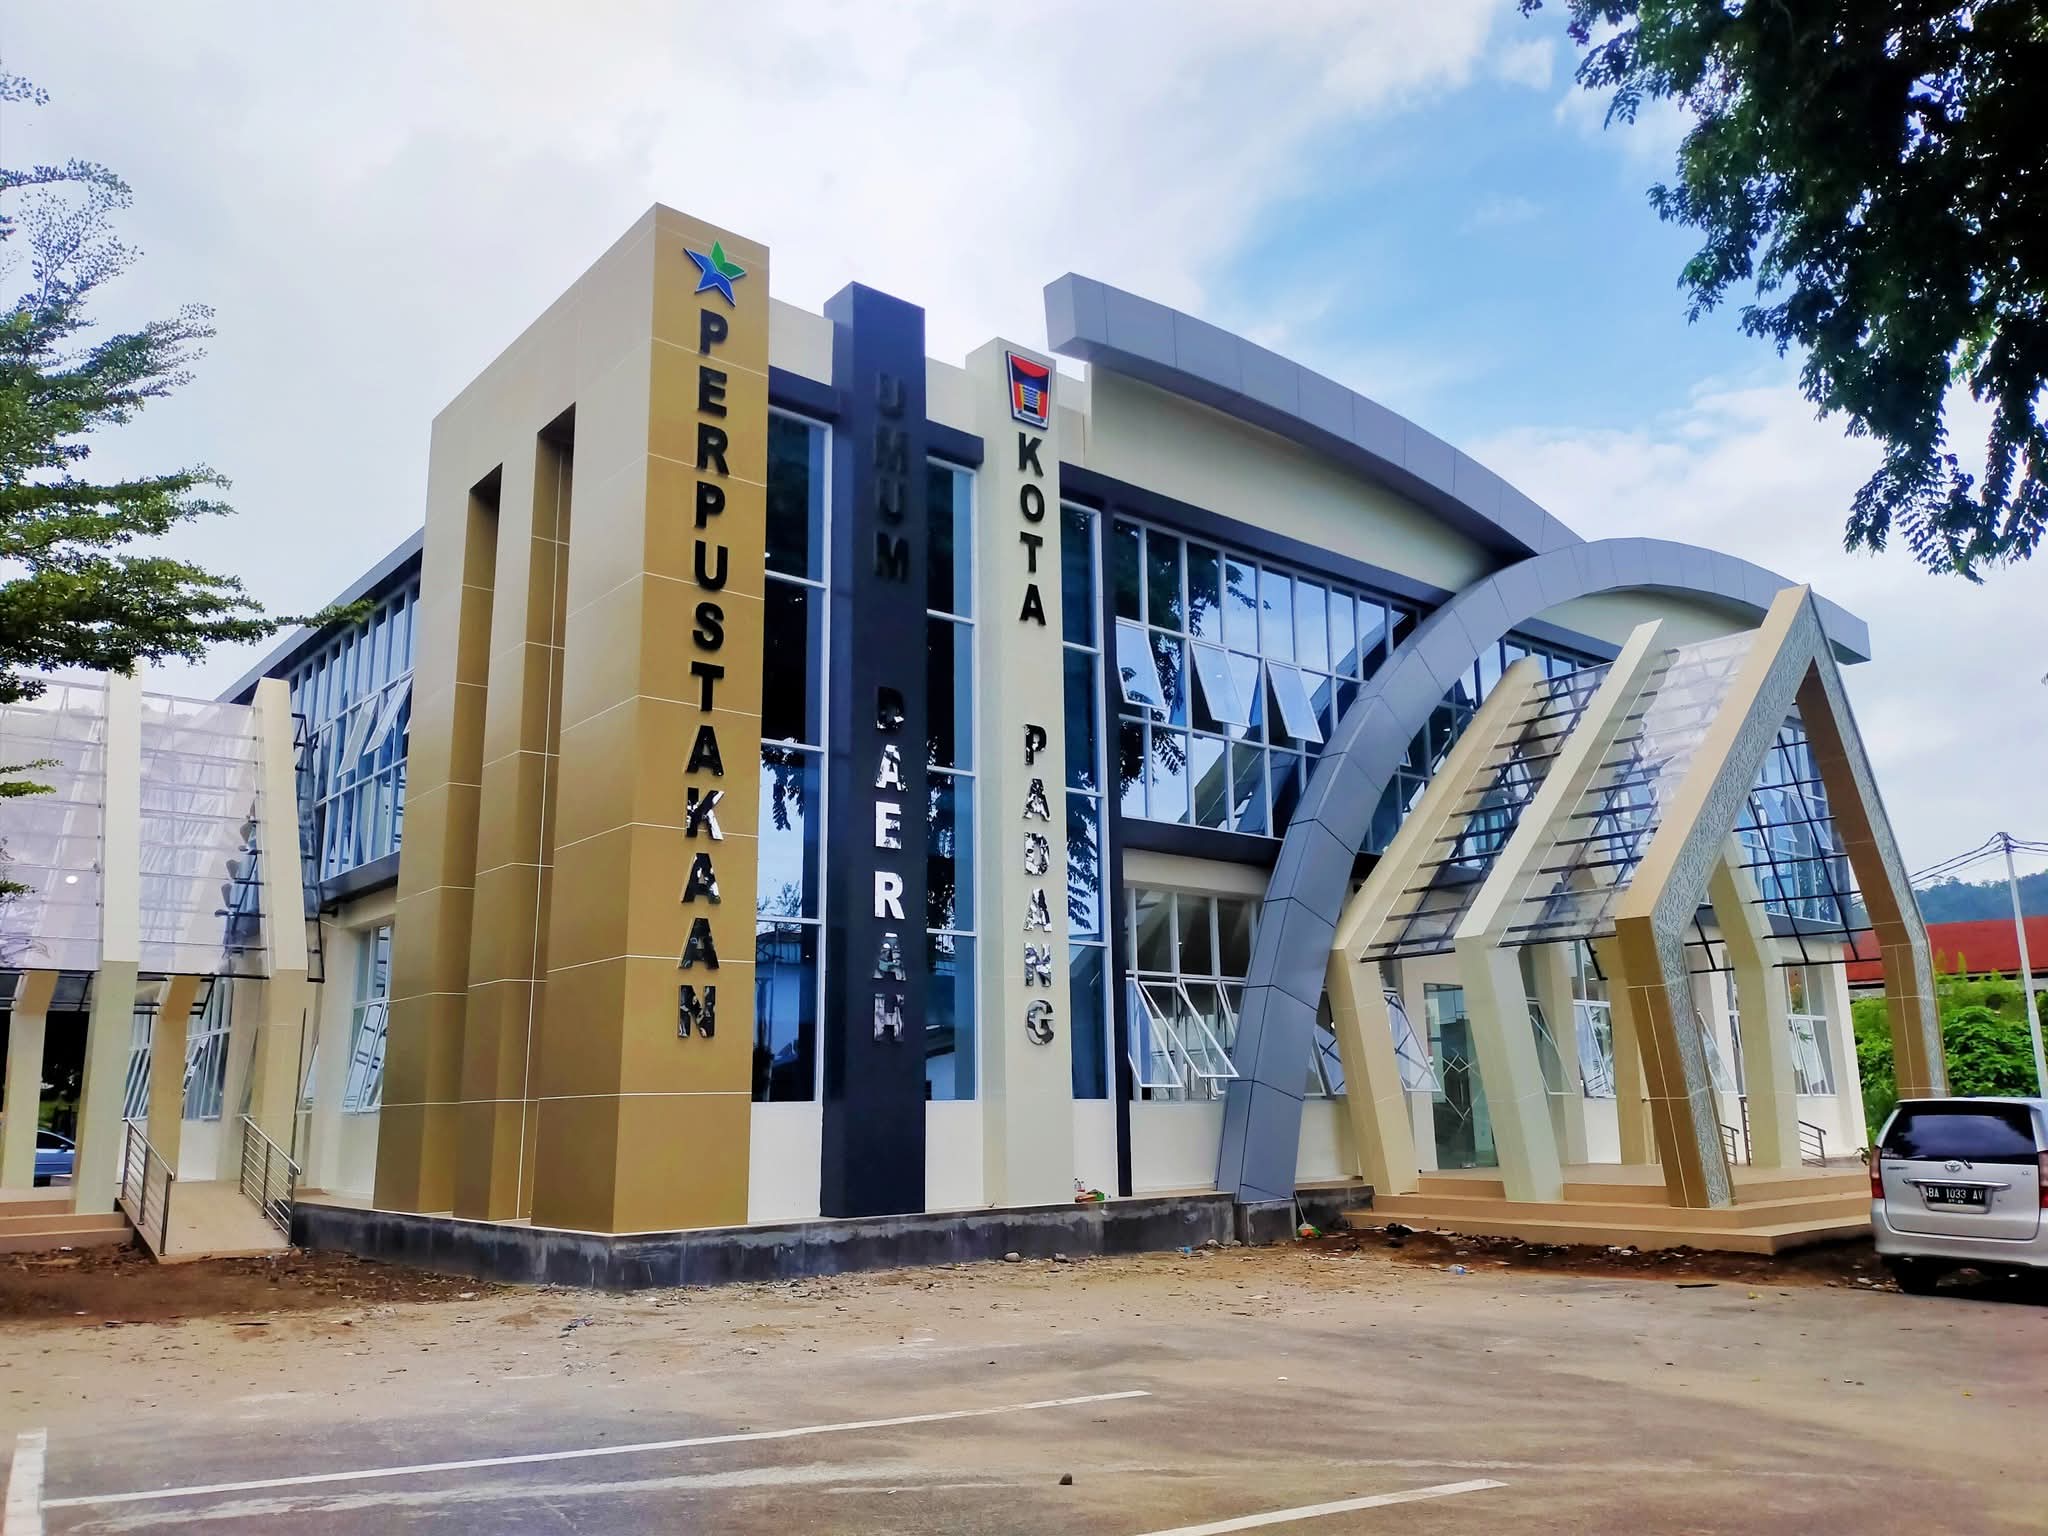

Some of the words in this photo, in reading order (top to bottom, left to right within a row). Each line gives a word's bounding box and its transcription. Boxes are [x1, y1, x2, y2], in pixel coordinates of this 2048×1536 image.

[873, 372, 910, 584] UMUM
[1018, 432, 1046, 627] KOTA
[677, 308, 729, 1039] PERPUSTAKAAN
[872, 686, 908, 1042] DAERAH
[1023, 723, 1054, 1046] PADANG
[1928, 1187, 1940, 1198] BA
[1946, 1188, 1967, 1199] 1033
[1973, 1189, 1983, 1200] AV
